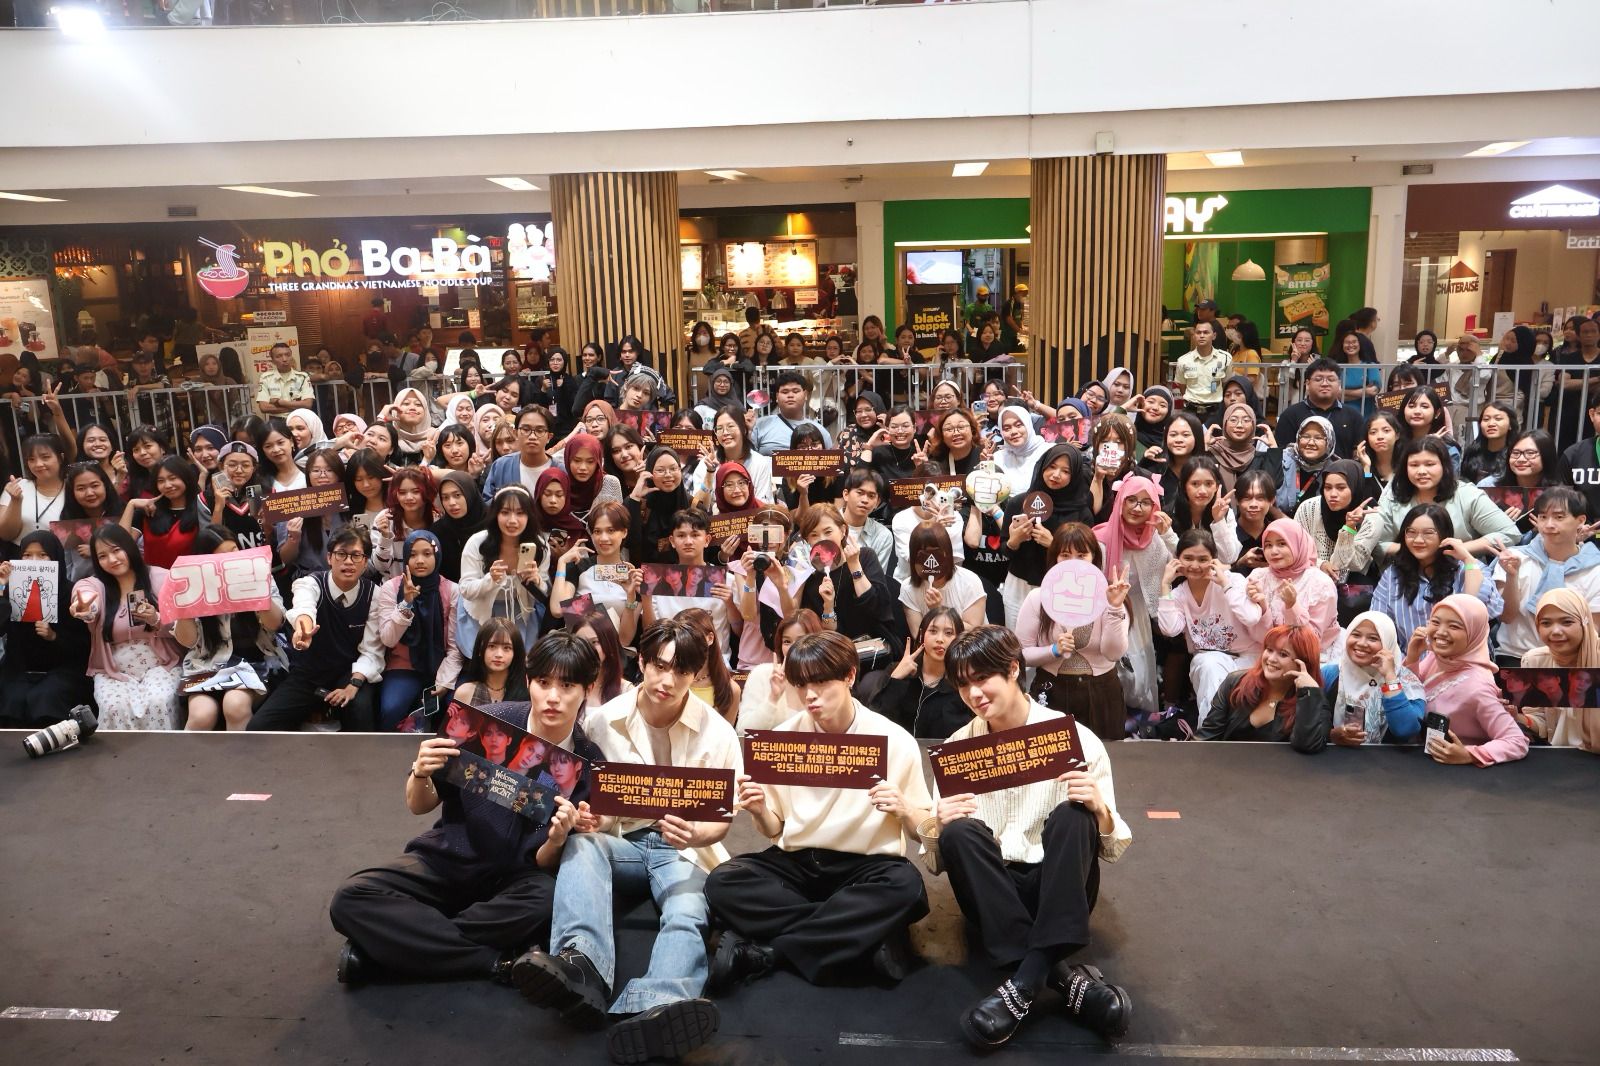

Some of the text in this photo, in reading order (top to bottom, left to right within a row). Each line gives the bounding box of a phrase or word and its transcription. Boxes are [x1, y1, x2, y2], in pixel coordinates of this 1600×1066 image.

[263, 234, 492, 278] Phở Ba Bà
[268, 282, 299, 292] THREE
[301, 280, 359, 290] GRANDMA'S
[360, 280, 420, 289] VIETNAMESE
[424, 278, 464, 288] NOODLE
[466, 276, 492, 286] SOUP
[1288, 280, 1318, 288] BITES
[914, 312, 948, 323] black
[913, 322, 950, 331] pepper
[170, 556, 270, 606] 가람
[752, 742, 880, 756] 인도네시아에 와줘서 고마워요!
[938, 730, 1071, 766] 인도네시아에 와줘서 고마워요!
[753, 752, 878, 766] ASC2NT는 저희의 별이에요!
[944, 741, 1071, 776] ASC2NT는 저희의 별이에요!
[495, 769, 518, 785] Welcome
[598, 773, 727, 790] 인도네시아에 와줘서 고마워요!
[600, 784, 724, 800] ASC2NT는 저희의 별이에요!
